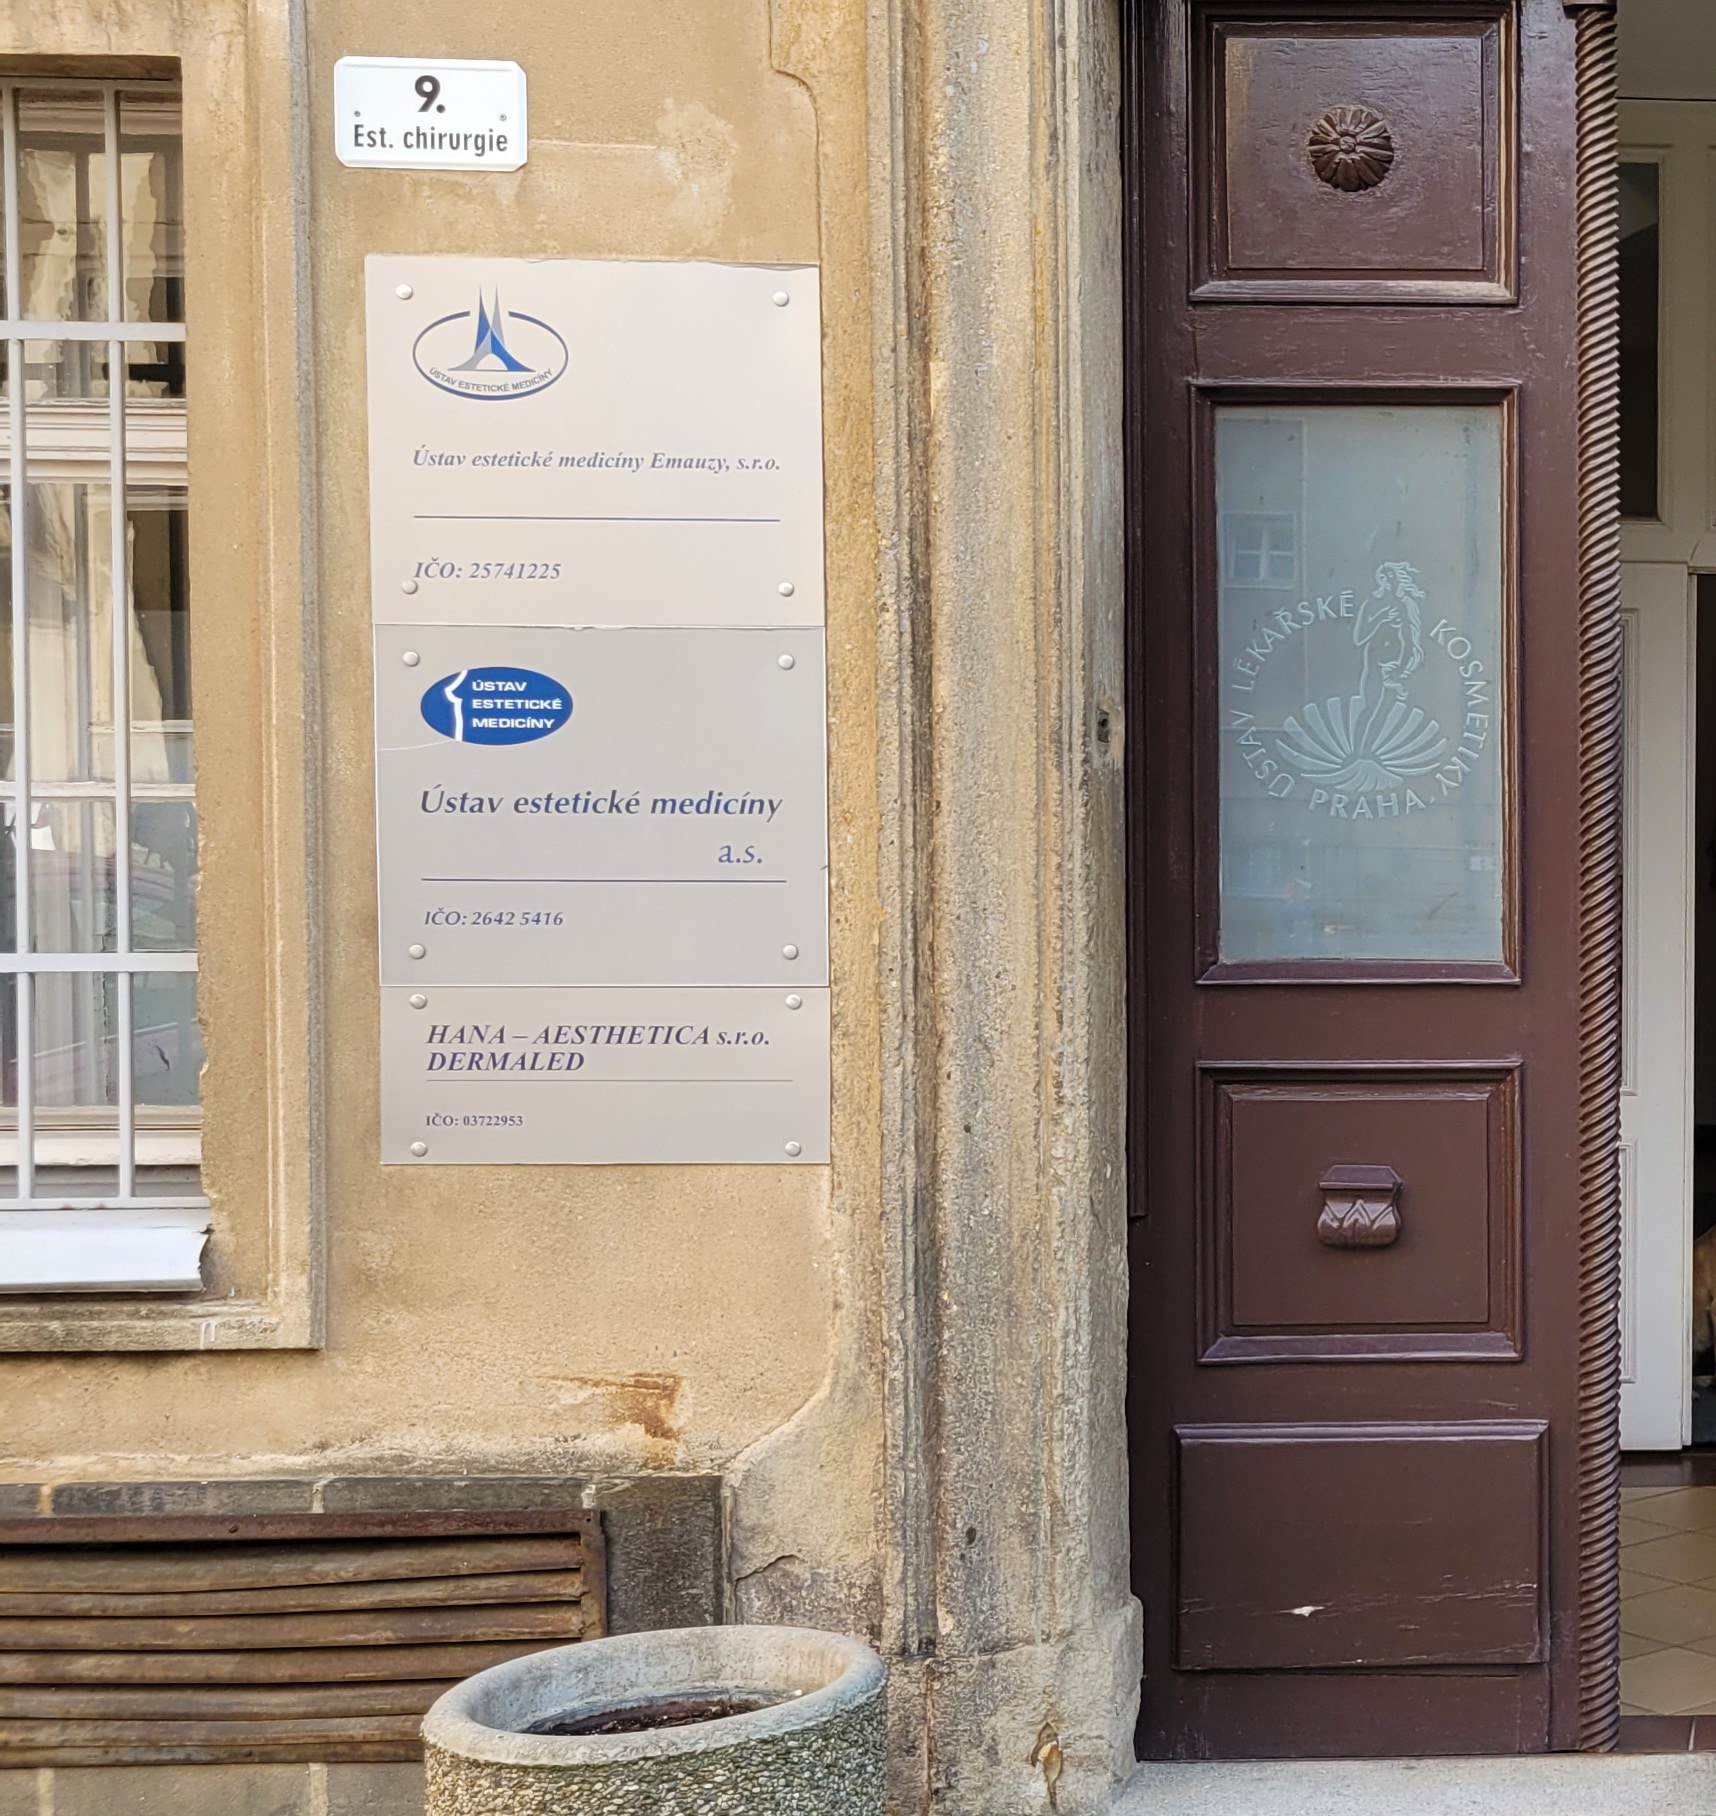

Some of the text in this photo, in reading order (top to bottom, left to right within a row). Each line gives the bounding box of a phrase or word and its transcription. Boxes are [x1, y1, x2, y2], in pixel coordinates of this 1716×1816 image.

[414, 74, 446, 114] 9.
[354, 124, 508, 157] Est. chirurgie
[429, 366, 553, 393] ÚSTAV ESTETICKÉ MEDICÍNY
[413, 444, 781, 474] Ústav estetické medicíny Emauzy, s.r.o.
[414, 557, 561, 579] IČO: 25741225
[1232, 590, 1354, 695] LÉKAŘSKÉ
[472, 679, 527, 692] ÚSTAV
[472, 698, 563, 710] ESTETICKÉ
[1429, 618, 1491, 797] KOSMETIKY
[472, 717, 555, 729] MEDICÍNY
[1230, 710, 1296, 798] ÚSTAV
[420, 784, 783, 822] Ústav estetické medicíny
[717, 844, 763, 865] a.s.
[424, 907, 563, 926] IČO: 2642 5416
[425, 1024, 506, 1045] HANA
[532, 1025, 710, 1046] AESTHETICA
[716, 1031, 771, 1046] s.r.o.
[425, 1051, 585, 1072] DERMALED
[425, 1112, 523, 1127] IČO: 03722953
